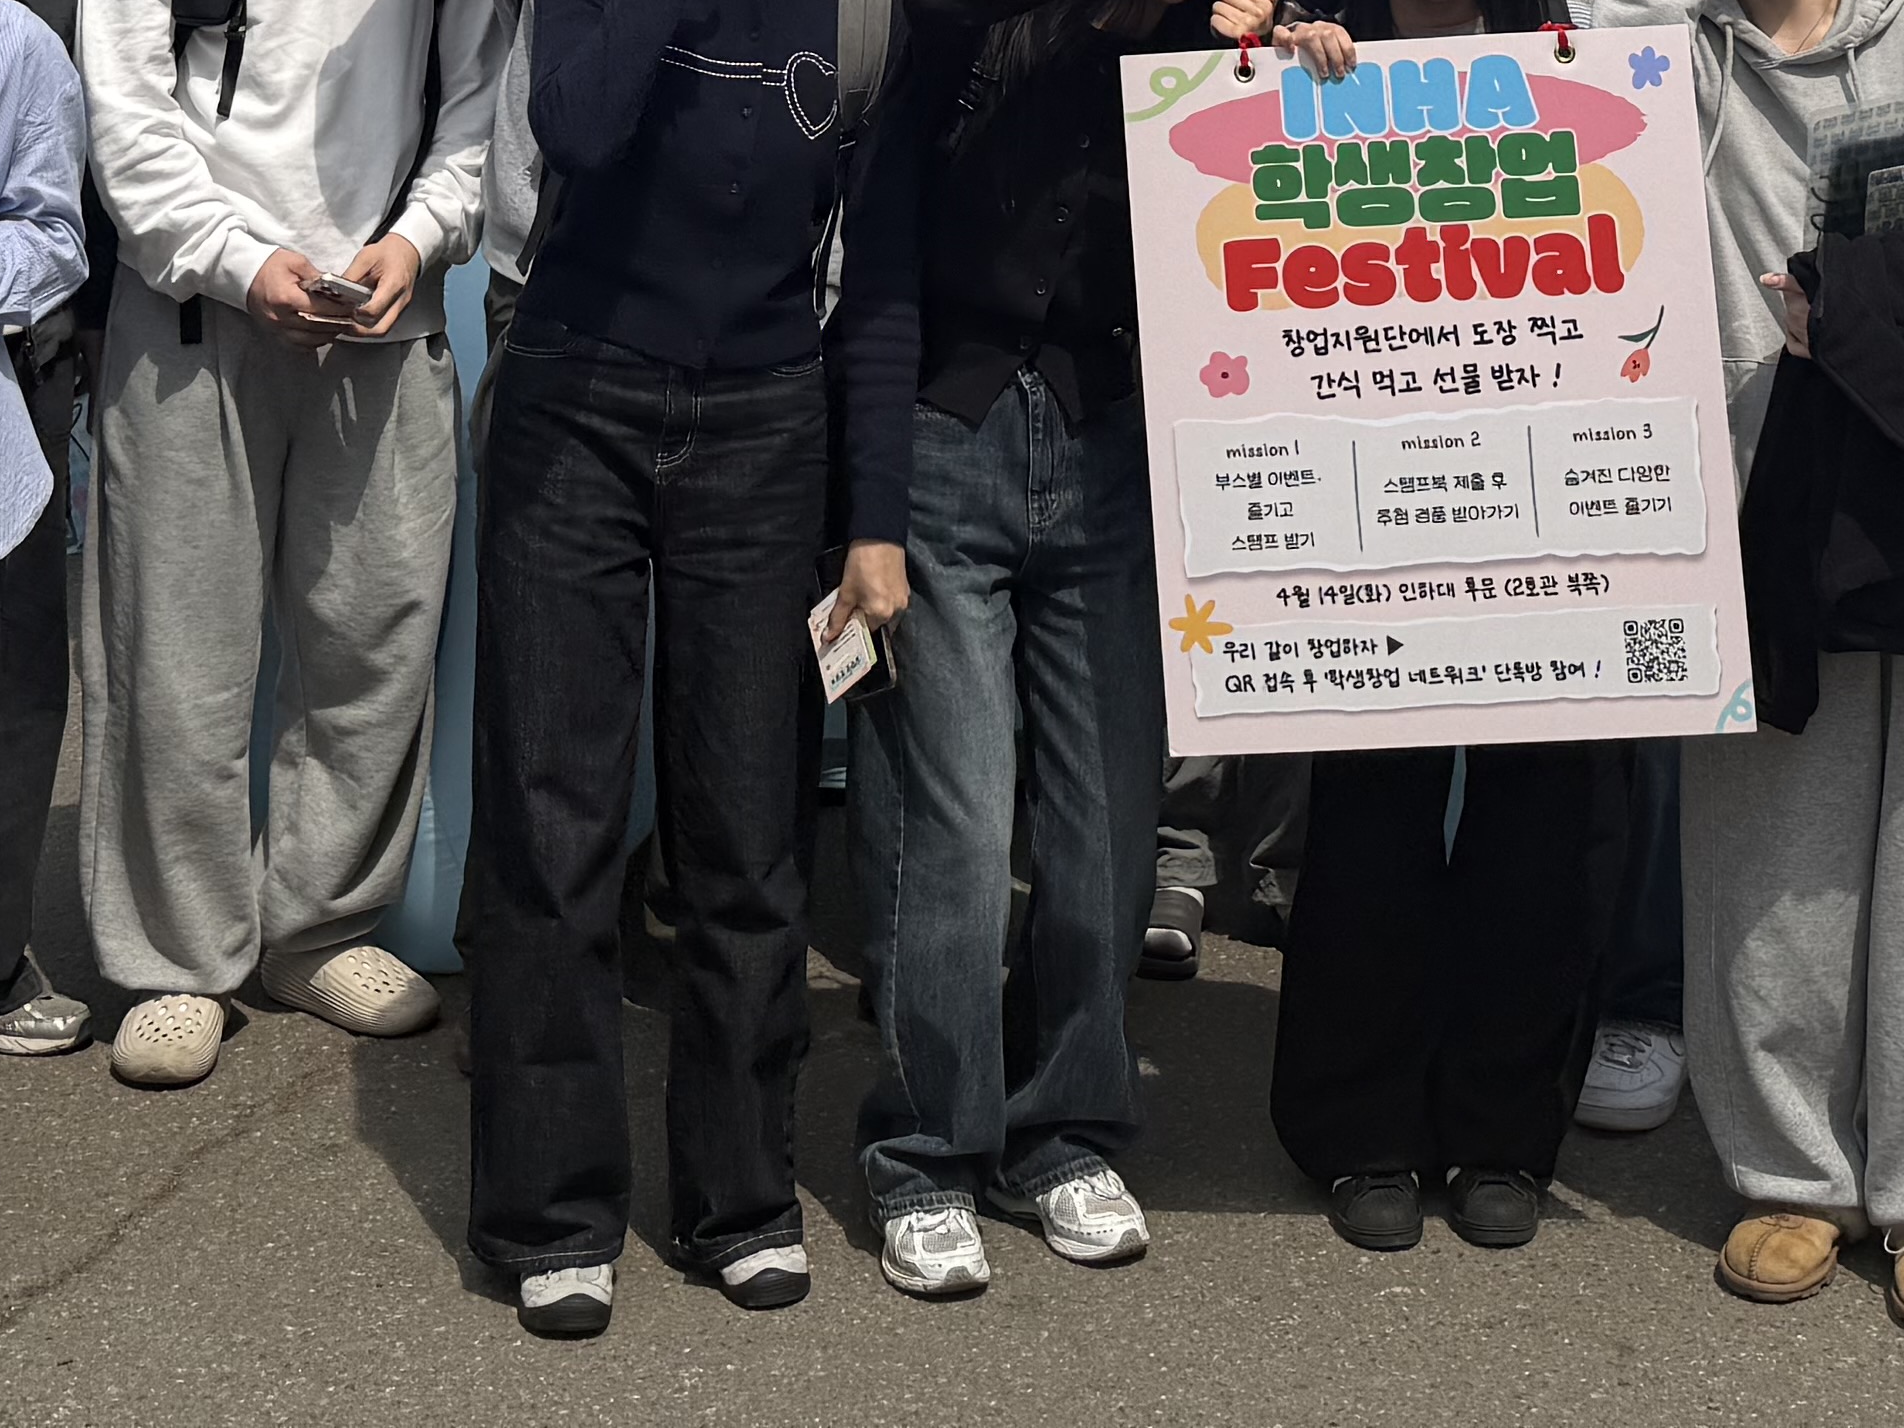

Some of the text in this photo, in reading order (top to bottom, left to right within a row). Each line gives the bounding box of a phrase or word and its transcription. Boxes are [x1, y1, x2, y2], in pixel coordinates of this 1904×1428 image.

[1280, 54, 1540, 141] INHA
[1250, 129, 1582, 230] 학생창업
[1222, 212, 1626, 313] Festival
[1282, 315, 1584, 357] 창업지원단에서 도장 찍고
[1310, 370, 1361, 400] 간식
[1372, 369, 1423, 397] 먹고
[1433, 363, 1482, 396] 선물
[1490, 363, 1541, 391] 받자
[1401, 431, 1482, 451] mission 2
[1572, 423, 1653, 443] mission 3
[1226, 443, 1289, 459] mission
[1215, 472, 1263, 491] 부스별
[1383, 474, 1448, 494] 스탬프북
[1452, 472, 1486, 492] 제출
[1564, 467, 1614, 487] 숨겨진
[1247, 501, 1294, 521] 즐기고
[1414, 506, 1447, 524] 경품
[1451, 503, 1520, 524] 받아가기
[1569, 496, 1673, 518] 이벤트 즐기기
[1231, 531, 1316, 552] 스탬프 받기
[1276, 585, 1311, 609] 4월
[1398, 581, 1456, 603] 인하대
[1464, 576, 1498, 603] 후문
[1504, 575, 1559, 598] (2호관
[1566, 572, 1610, 596] 북쪽)
[1222, 638, 1379, 663] 우리 같이 창업하자
[1225, 673, 1256, 694] QR
[1262, 670, 1296, 694] 접속
[1302, 668, 1318, 694] 후
[1494, 660, 1543, 683] 단톡방
[1550, 660, 1586, 682] 참여
